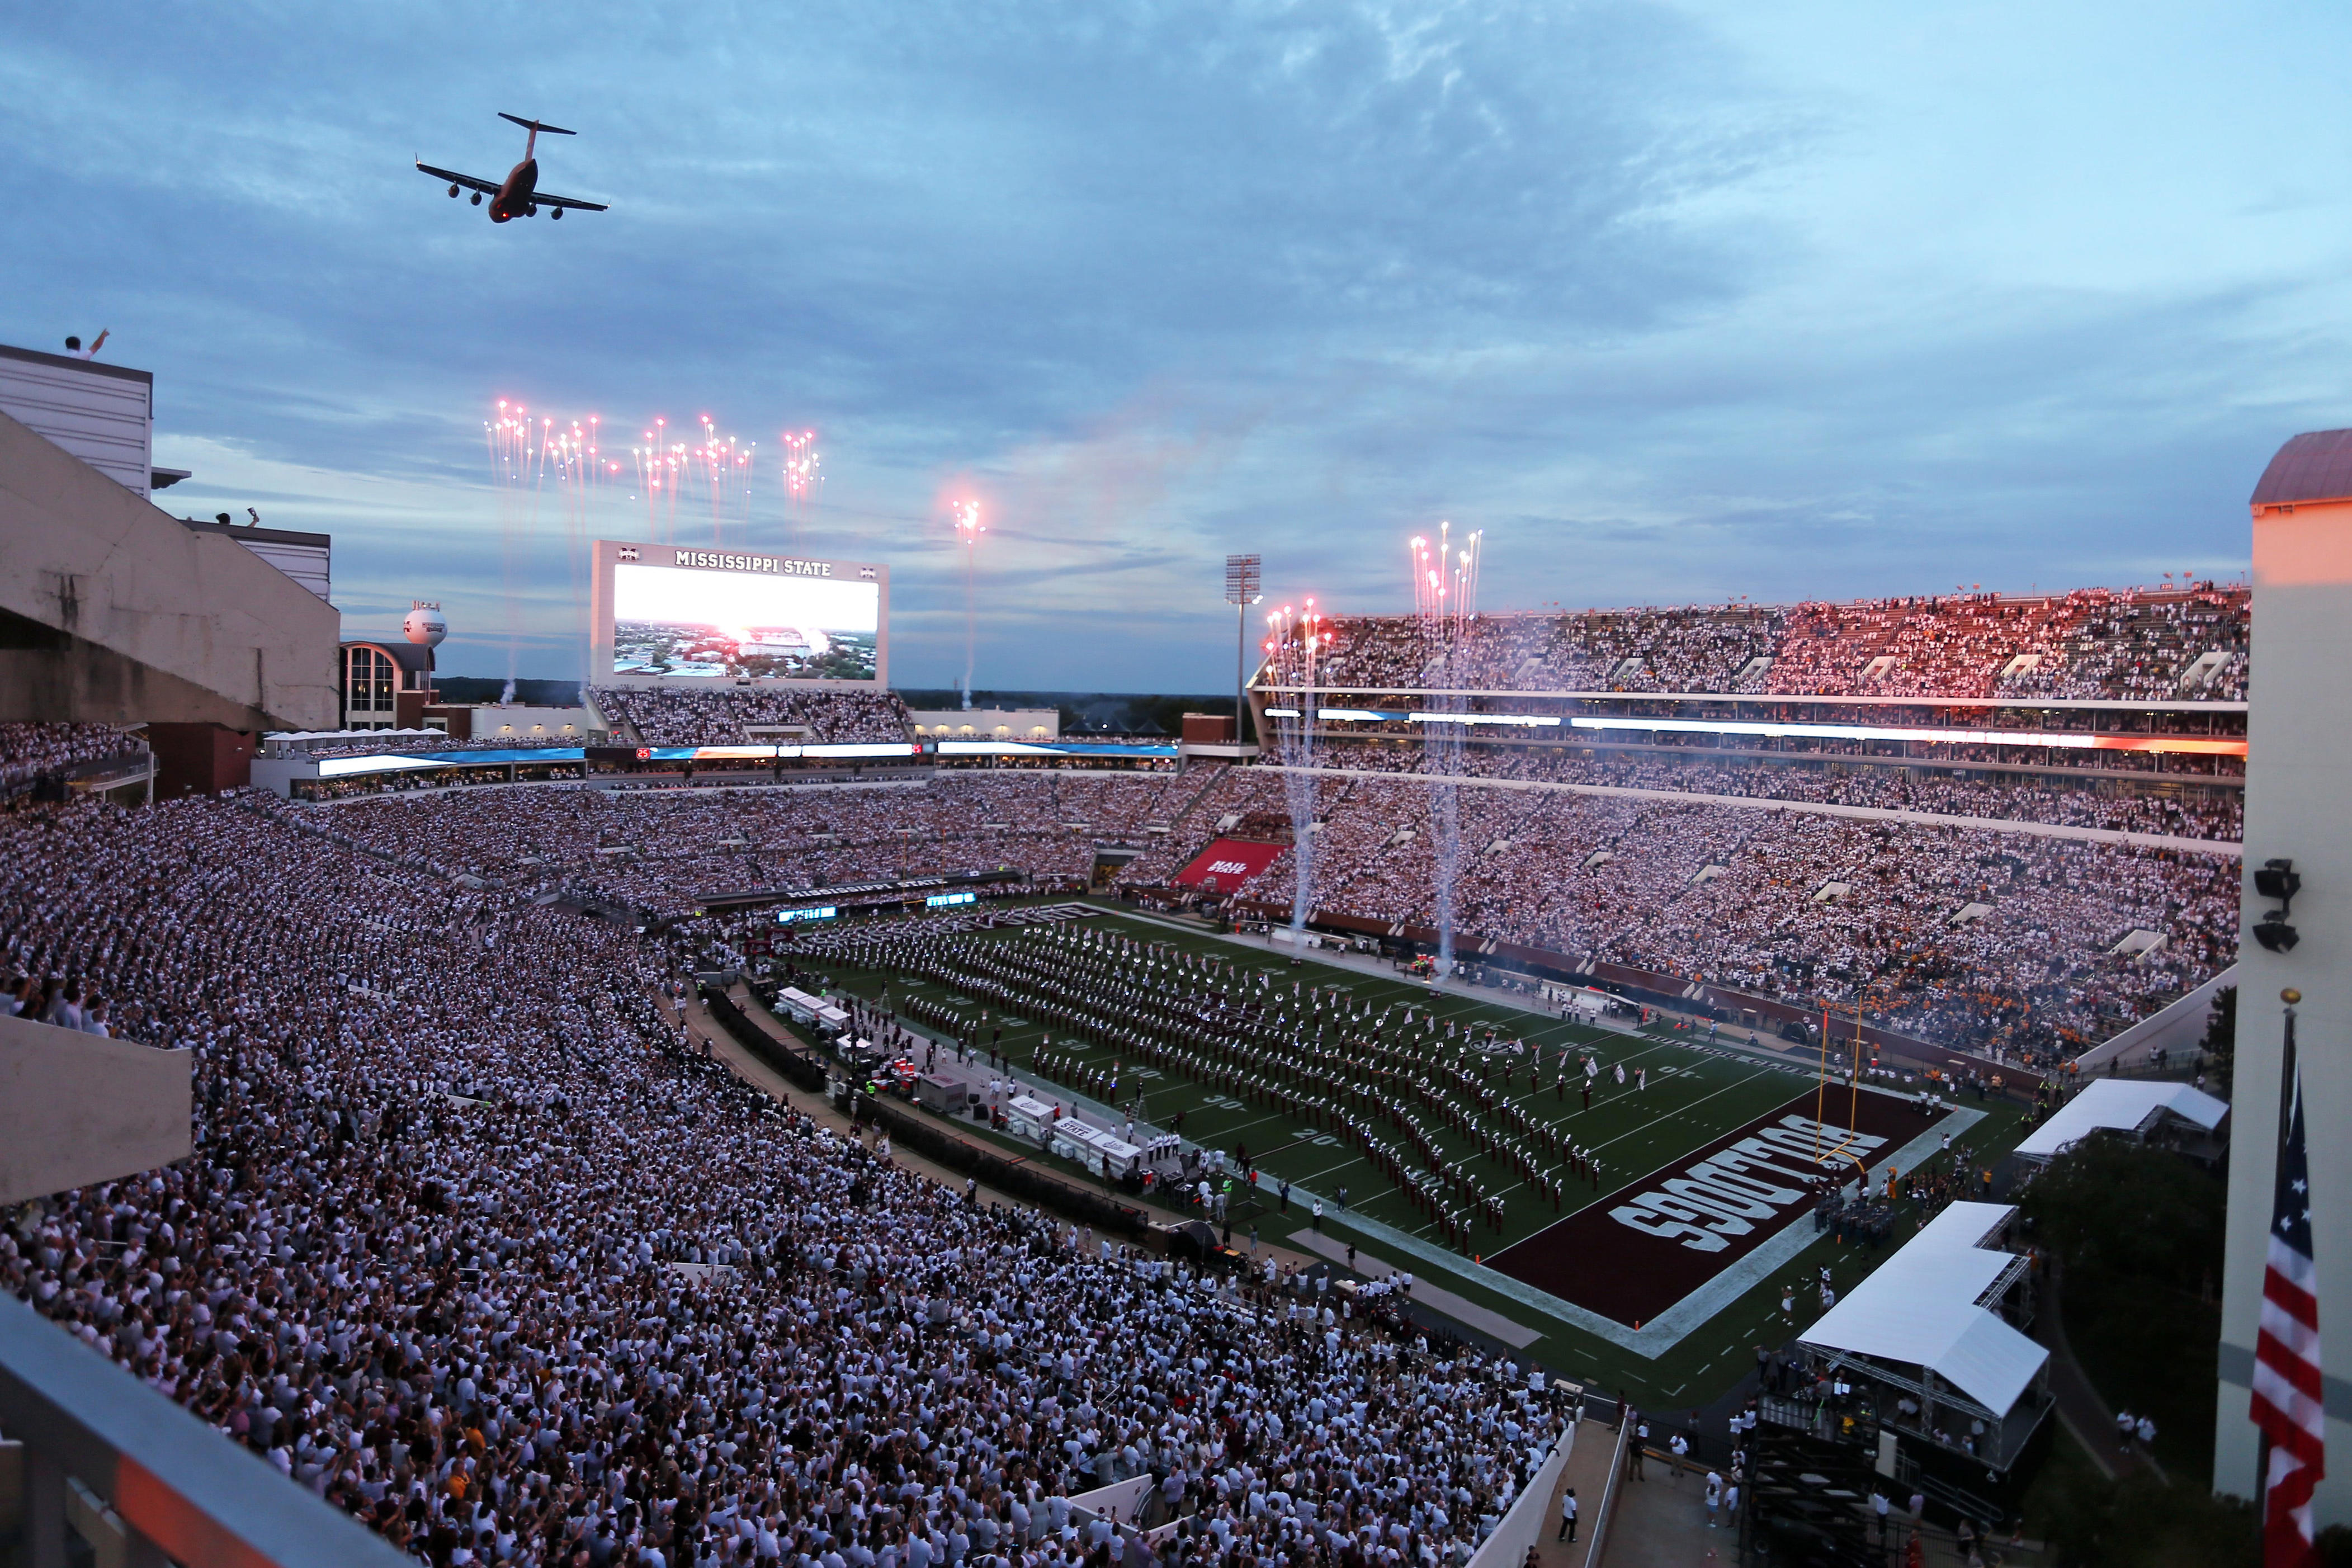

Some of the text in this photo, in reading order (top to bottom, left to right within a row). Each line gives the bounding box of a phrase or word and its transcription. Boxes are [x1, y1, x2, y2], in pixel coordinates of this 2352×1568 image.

[675, 550, 831, 577] MISSISSIPPI STATE
[1207, 866, 1243, 875] STATE
[1212, 861, 1246, 870] HAIL
[786, 879, 948, 898] MISSISSIPPI STATE
[1057, 1039, 1092, 1051] 50
[1641, 1034, 1812, 1075] BULLDOG CLUB
[1657, 1066, 1695, 1078] 10
[1203, 1094, 1243, 1109] 30
[1060, 1122, 1089, 1136] STATE
[1292, 1128, 1337, 1146] 20
[1608, 1114, 1890, 1253] BULLDOGS
[1328, 1400, 1336, 1410] 70
